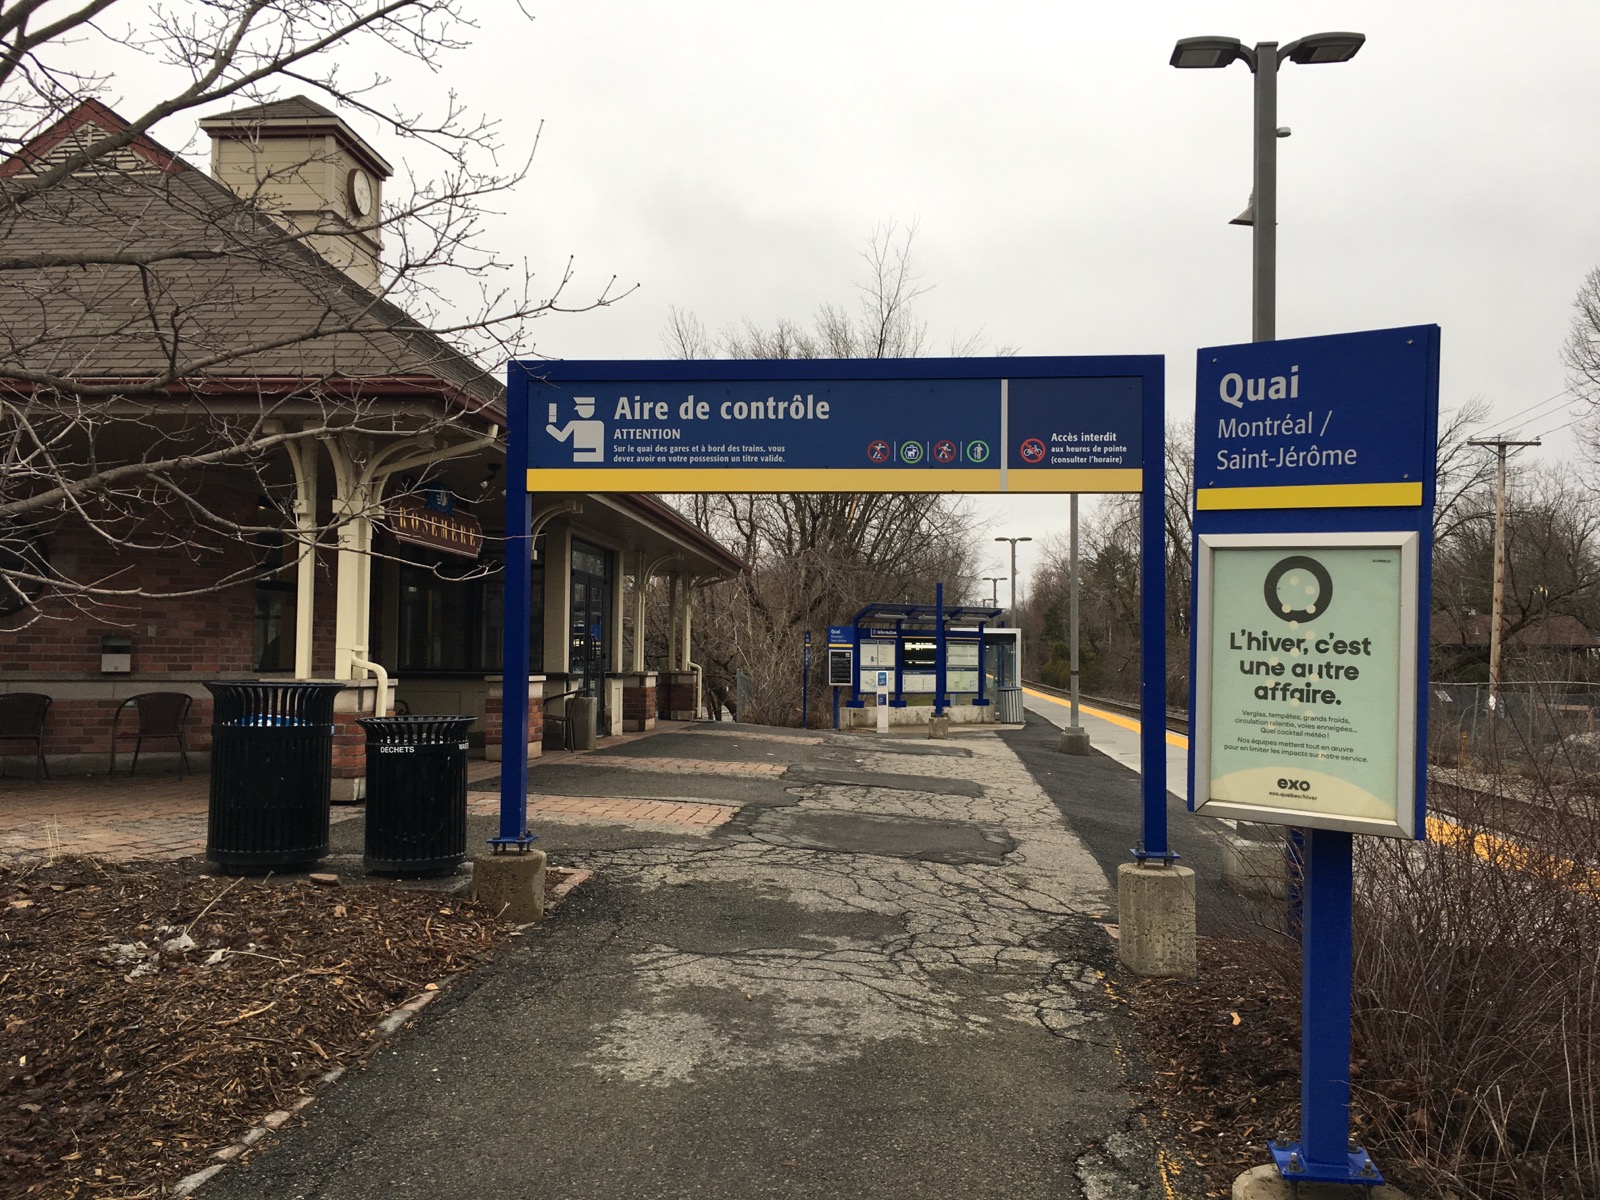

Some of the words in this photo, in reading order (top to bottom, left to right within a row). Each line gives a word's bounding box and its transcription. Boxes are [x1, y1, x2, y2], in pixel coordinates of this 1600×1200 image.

[1219, 364, 1299, 409] Quai
[613, 395, 669, 420] Aire
[679, 394, 709, 420] de
[720, 394, 830, 420] contrôle
[1218, 411, 1313, 439] Montréal
[1319, 410, 1333, 437] /
[613, 428, 681, 440] ATTENTION
[1051, 432, 1078, 442] Accès
[1081, 432, 1117, 442] interdit
[613, 444, 626, 453] Sur
[628, 444, 635, 453] le
[636, 444, 653, 454] quai
[655, 444, 668, 453] des
[669, 446, 690, 454] gares
[691, 445, 700, 453] et
[701, 444, 706, 453] à
[707, 444, 726, 453] bord
[727, 444, 740, 453] des
[742, 444, 766, 454] trains,
[1066, 445, 1090, 453] heures
[1092, 445, 1102, 453] de
[1103, 445, 1127, 454] pointe
[613, 455, 635, 463] devez
[636, 455, 656, 463] avoir
[668, 455, 688, 463] votre
[689, 455, 729, 464] possession
[742, 454, 759, 463] titre
[760, 454, 785, 463] valide.
[1051, 455, 1087, 464] (consulter
[1089, 455, 1123, 465] l'horaire)
[1217, 444, 1357, 471] Saint-Jérôme
[1229, 628, 1309, 656] L'hiver,
[1314, 632, 1371, 656] c'est
[1239, 660, 1286, 677] une
[1291, 661, 1359, 681] autre
[1254, 682, 1342, 706] affaire.
[1235, 718, 1269, 726] circulation
[1269, 720, 1297, 729] ralentie,
[1297, 722, 1316, 730] voies
[1242, 710, 1268, 718] Verglas,
[1268, 712, 1303, 721] tempêtes,
[1303, 714, 1328, 722] grands
[1328, 716, 1351, 724] froids,
[1260, 727, 1276, 735] Quel
[1277, 728, 1304, 737] cocktail
[1237, 736, 1250, 744] Nos
[1251, 738, 1278, 747] équipes
[1278, 740, 1305, 749] mettent
[1306, 742, 1320, 750] tout
[1331, 745, 1354, 753] œuvre
[1224, 744, 1239, 752] pour
[1249, 745, 1270, 754] limiter
[1281, 748, 1309, 757] impacts
[1320, 752, 1340, 760] notre
[1340, 754, 1369, 763] service.
[1277, 778, 1311, 792] exo
